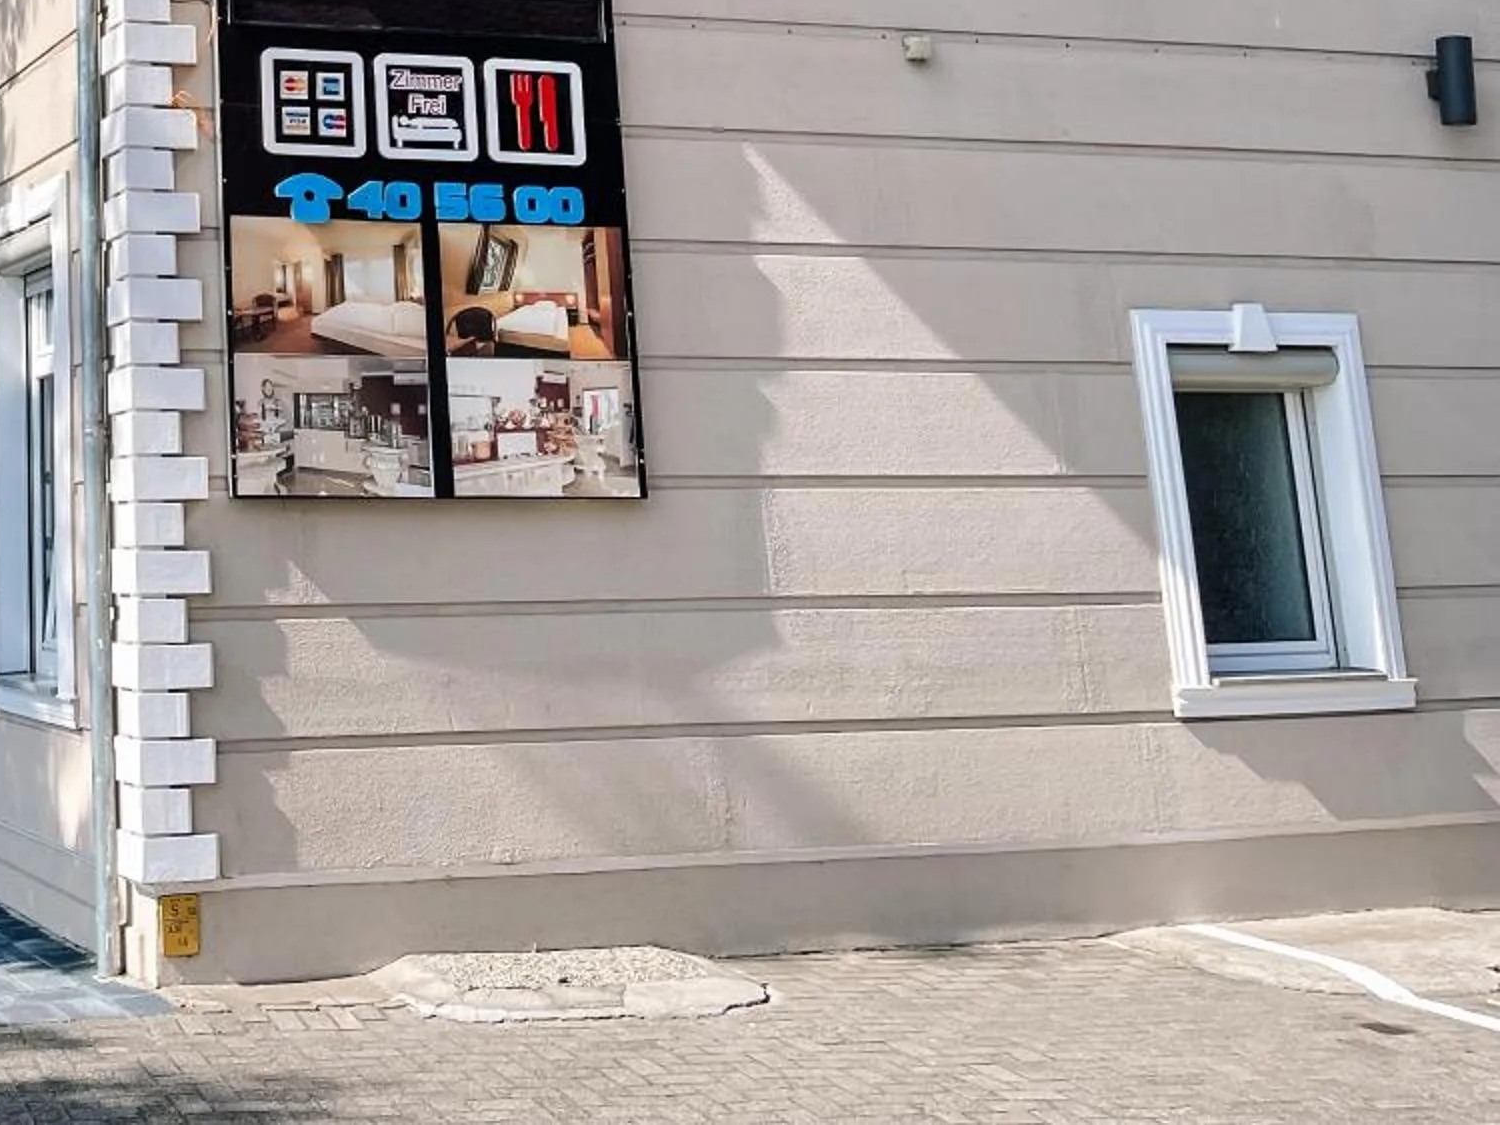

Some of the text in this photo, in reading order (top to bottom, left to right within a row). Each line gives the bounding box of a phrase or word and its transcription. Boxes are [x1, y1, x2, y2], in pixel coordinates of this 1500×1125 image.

[388, 68, 463, 92] Zimmer
[408, 93, 447, 115] Frei
[347, 180, 585, 224] 40 56 00
